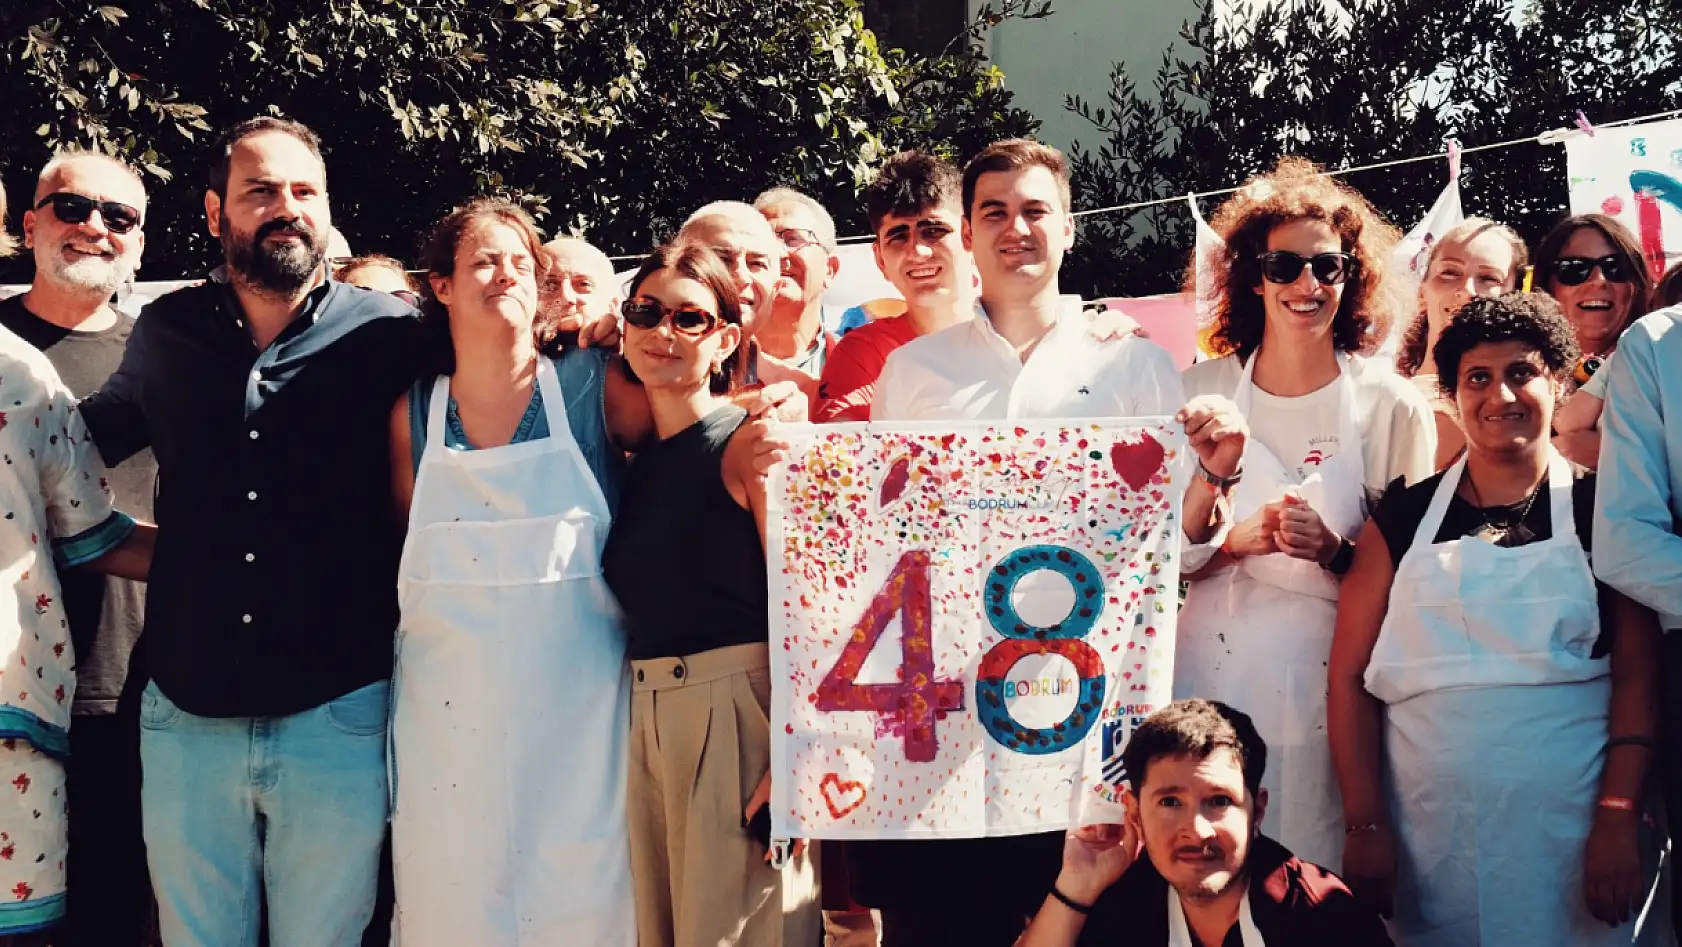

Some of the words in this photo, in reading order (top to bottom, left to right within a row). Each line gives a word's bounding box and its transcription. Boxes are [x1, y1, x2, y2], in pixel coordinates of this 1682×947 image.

[969, 498, 1028, 509] BODRUM
[814, 543, 1106, 763] 48
[1004, 677, 1073, 698] BODRUM
